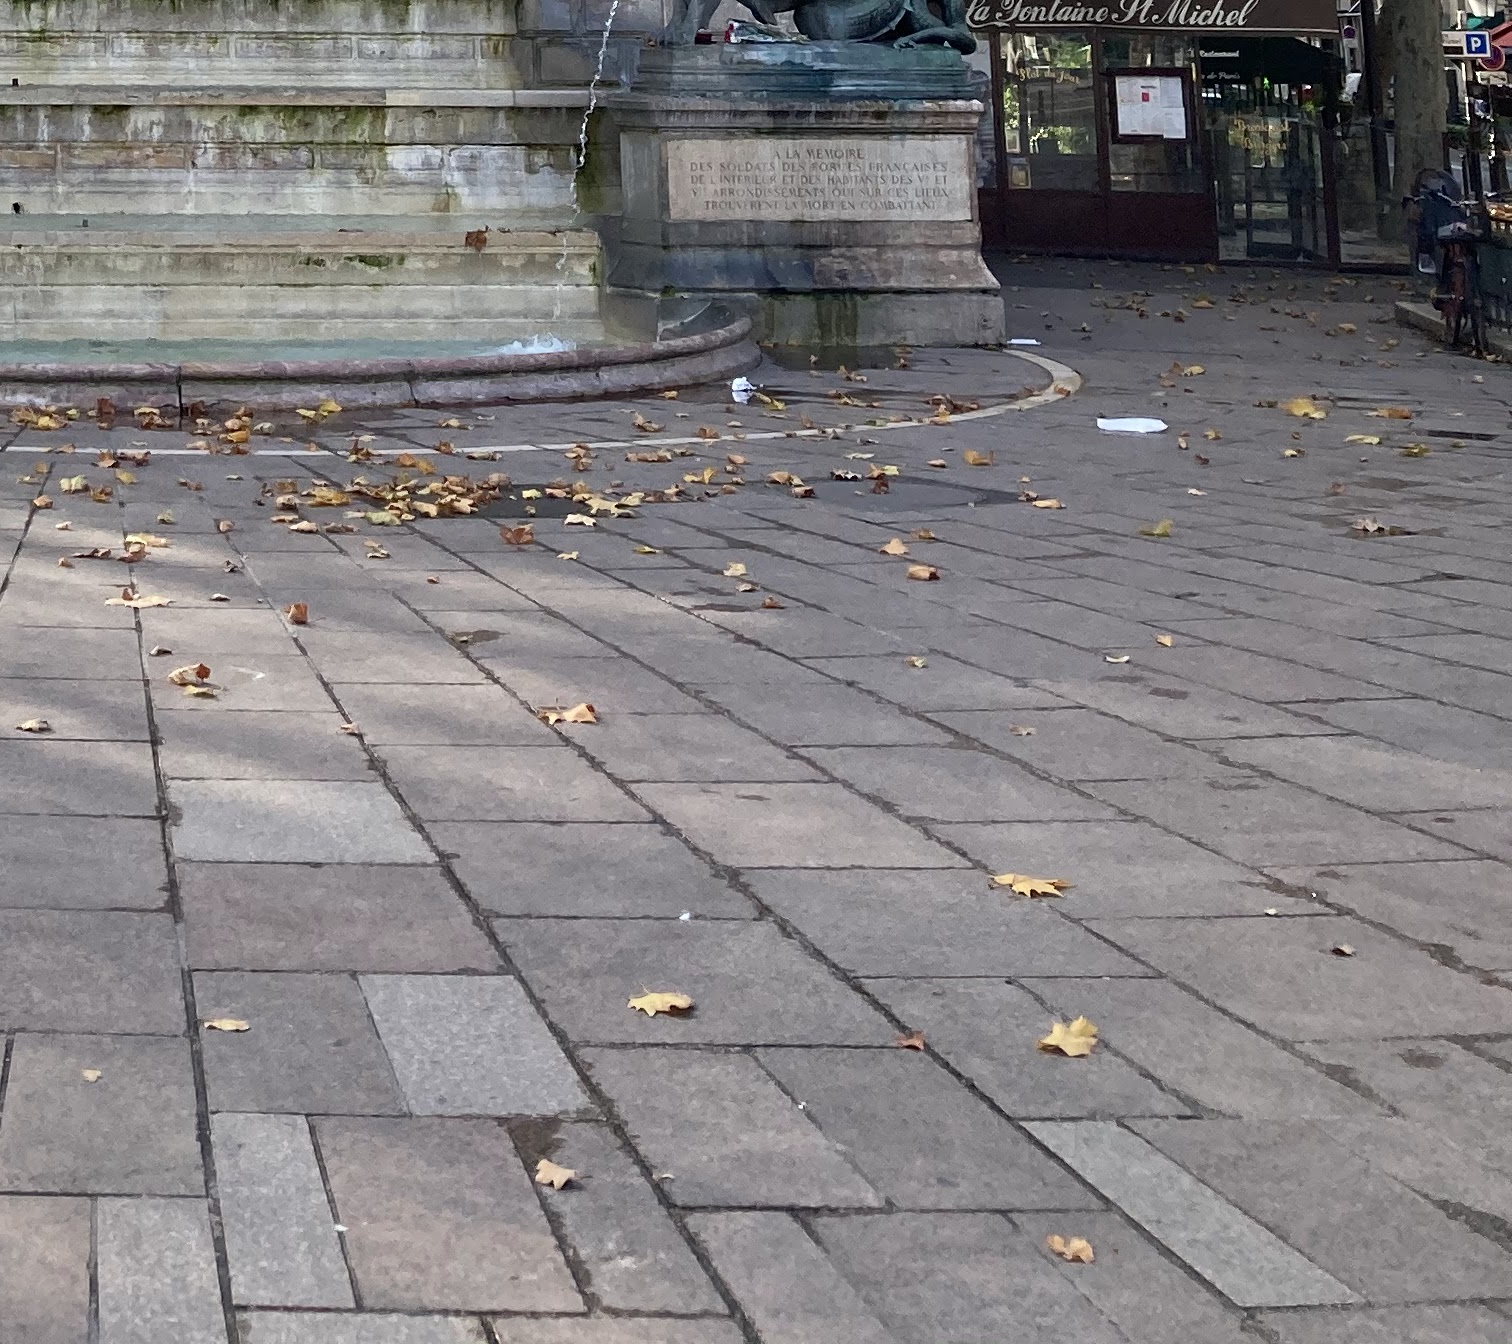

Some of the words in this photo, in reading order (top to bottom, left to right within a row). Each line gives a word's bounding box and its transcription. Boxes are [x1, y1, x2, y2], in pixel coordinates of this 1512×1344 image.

[1470, 36, 1482, 52] P
[786, 148, 801, 160] LA
[807, 148, 865, 160] MEMOIRE
[690, 162, 713, 172] DES
[719, 162, 776, 172] SOLDATS
[782, 162, 806, 172] DES
[690, 175, 705, 185] DE
[782, 175, 795, 185] ET
[827, 175, 886, 185] HABITANTS
[891, 175, 912, 185] DES
[935, 175, 948, 185] ET
[859, 188, 882, 198] SUR
[887, 188, 909, 198] CES
[915, 188, 949, 198] LIEUX
[806, 200, 834, 210] MORT
[841, 200, 856, 210] EN
[860, 200, 937, 210] COMBATTANT
